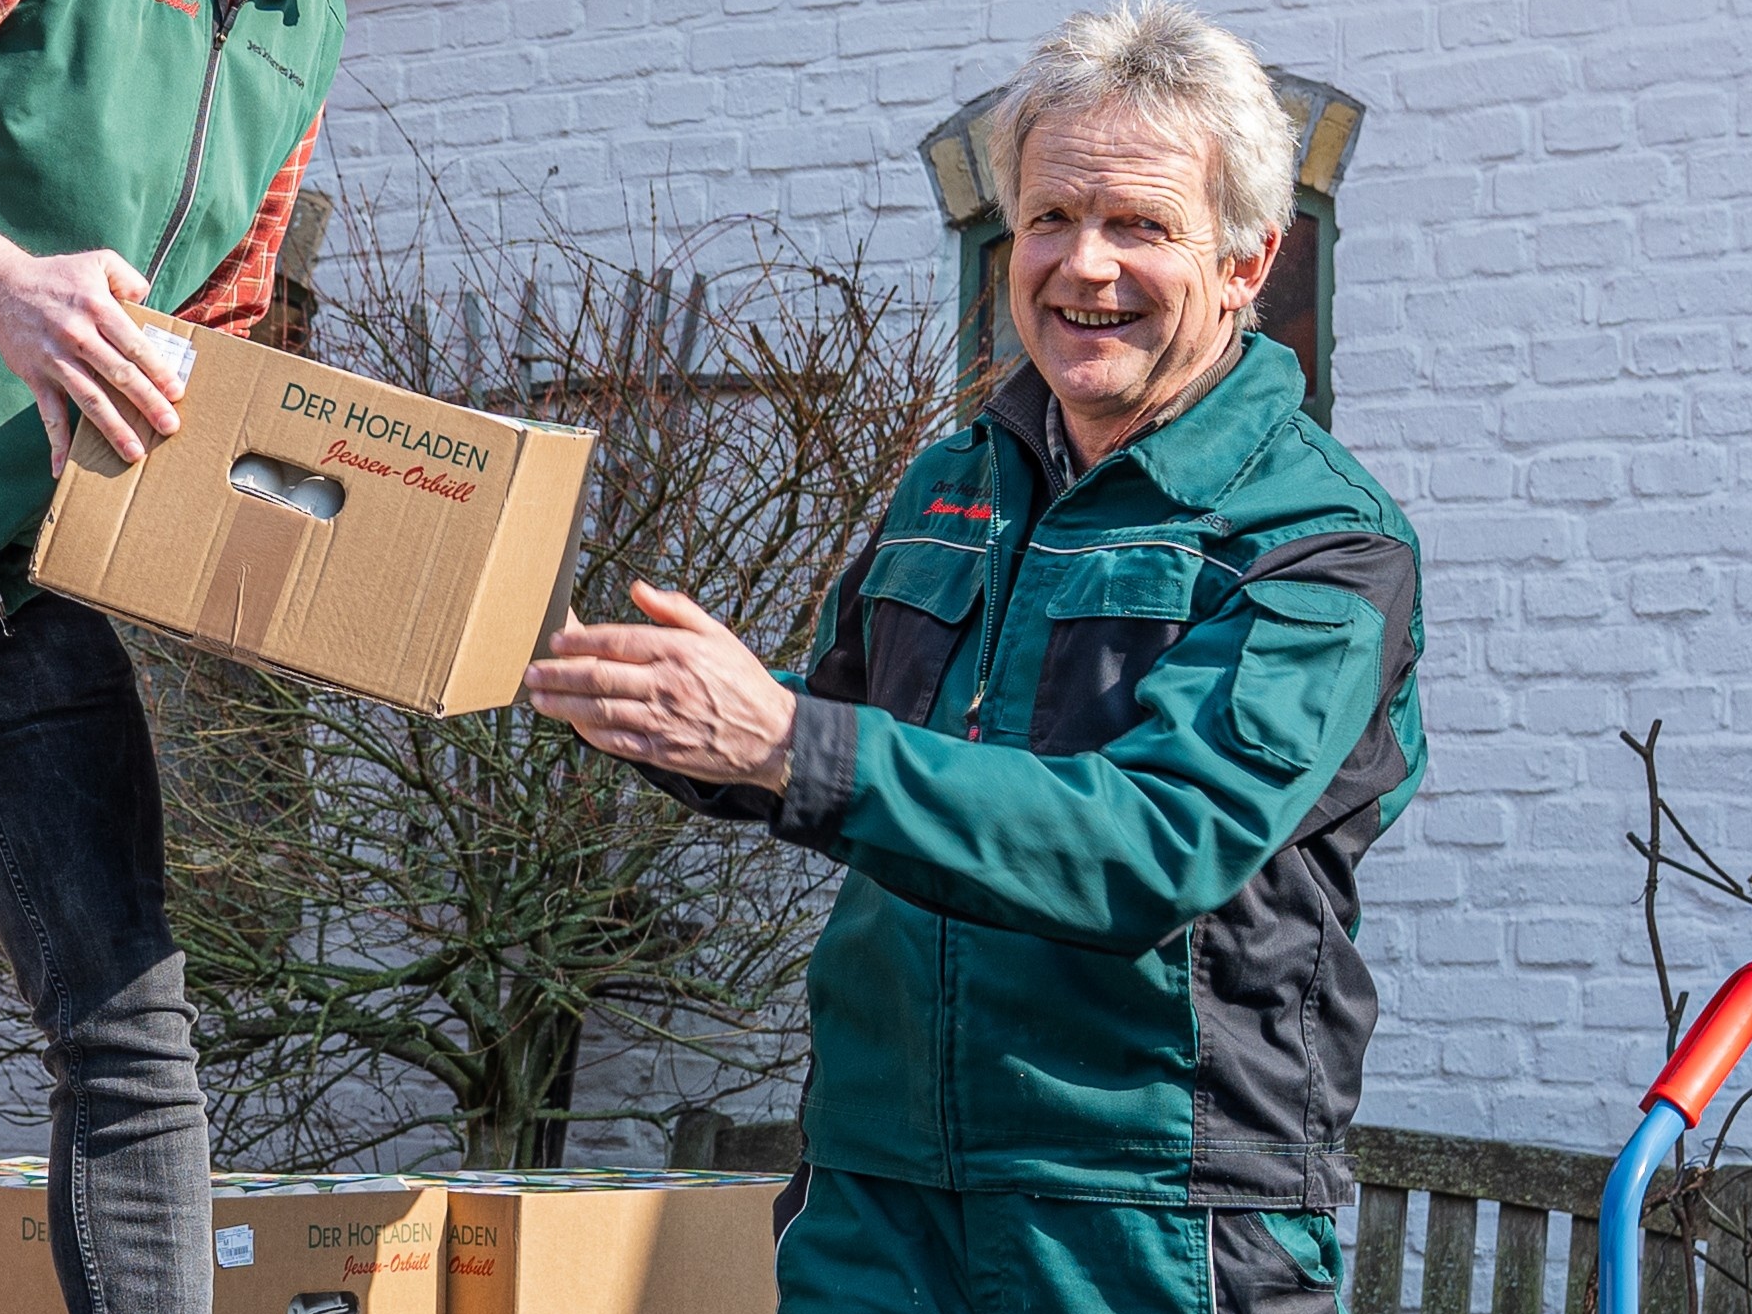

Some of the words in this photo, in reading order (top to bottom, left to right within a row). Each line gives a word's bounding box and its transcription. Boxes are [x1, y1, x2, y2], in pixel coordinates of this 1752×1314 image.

[280, 382, 337, 424] DER
[344, 402, 489, 473] HOFLADEN
[320, 439, 476, 503] Jessen-Oxbüll
[22, 1217, 48, 1242] DE
[308, 1224, 342, 1248] DER
[347, 1221, 433, 1245] HOFLADEN
[447, 1224, 497, 1247] ADEN
[343, 1253, 431, 1282] Jessen-Oxbüll
[448, 1255, 495, 1277] Oxbüll
